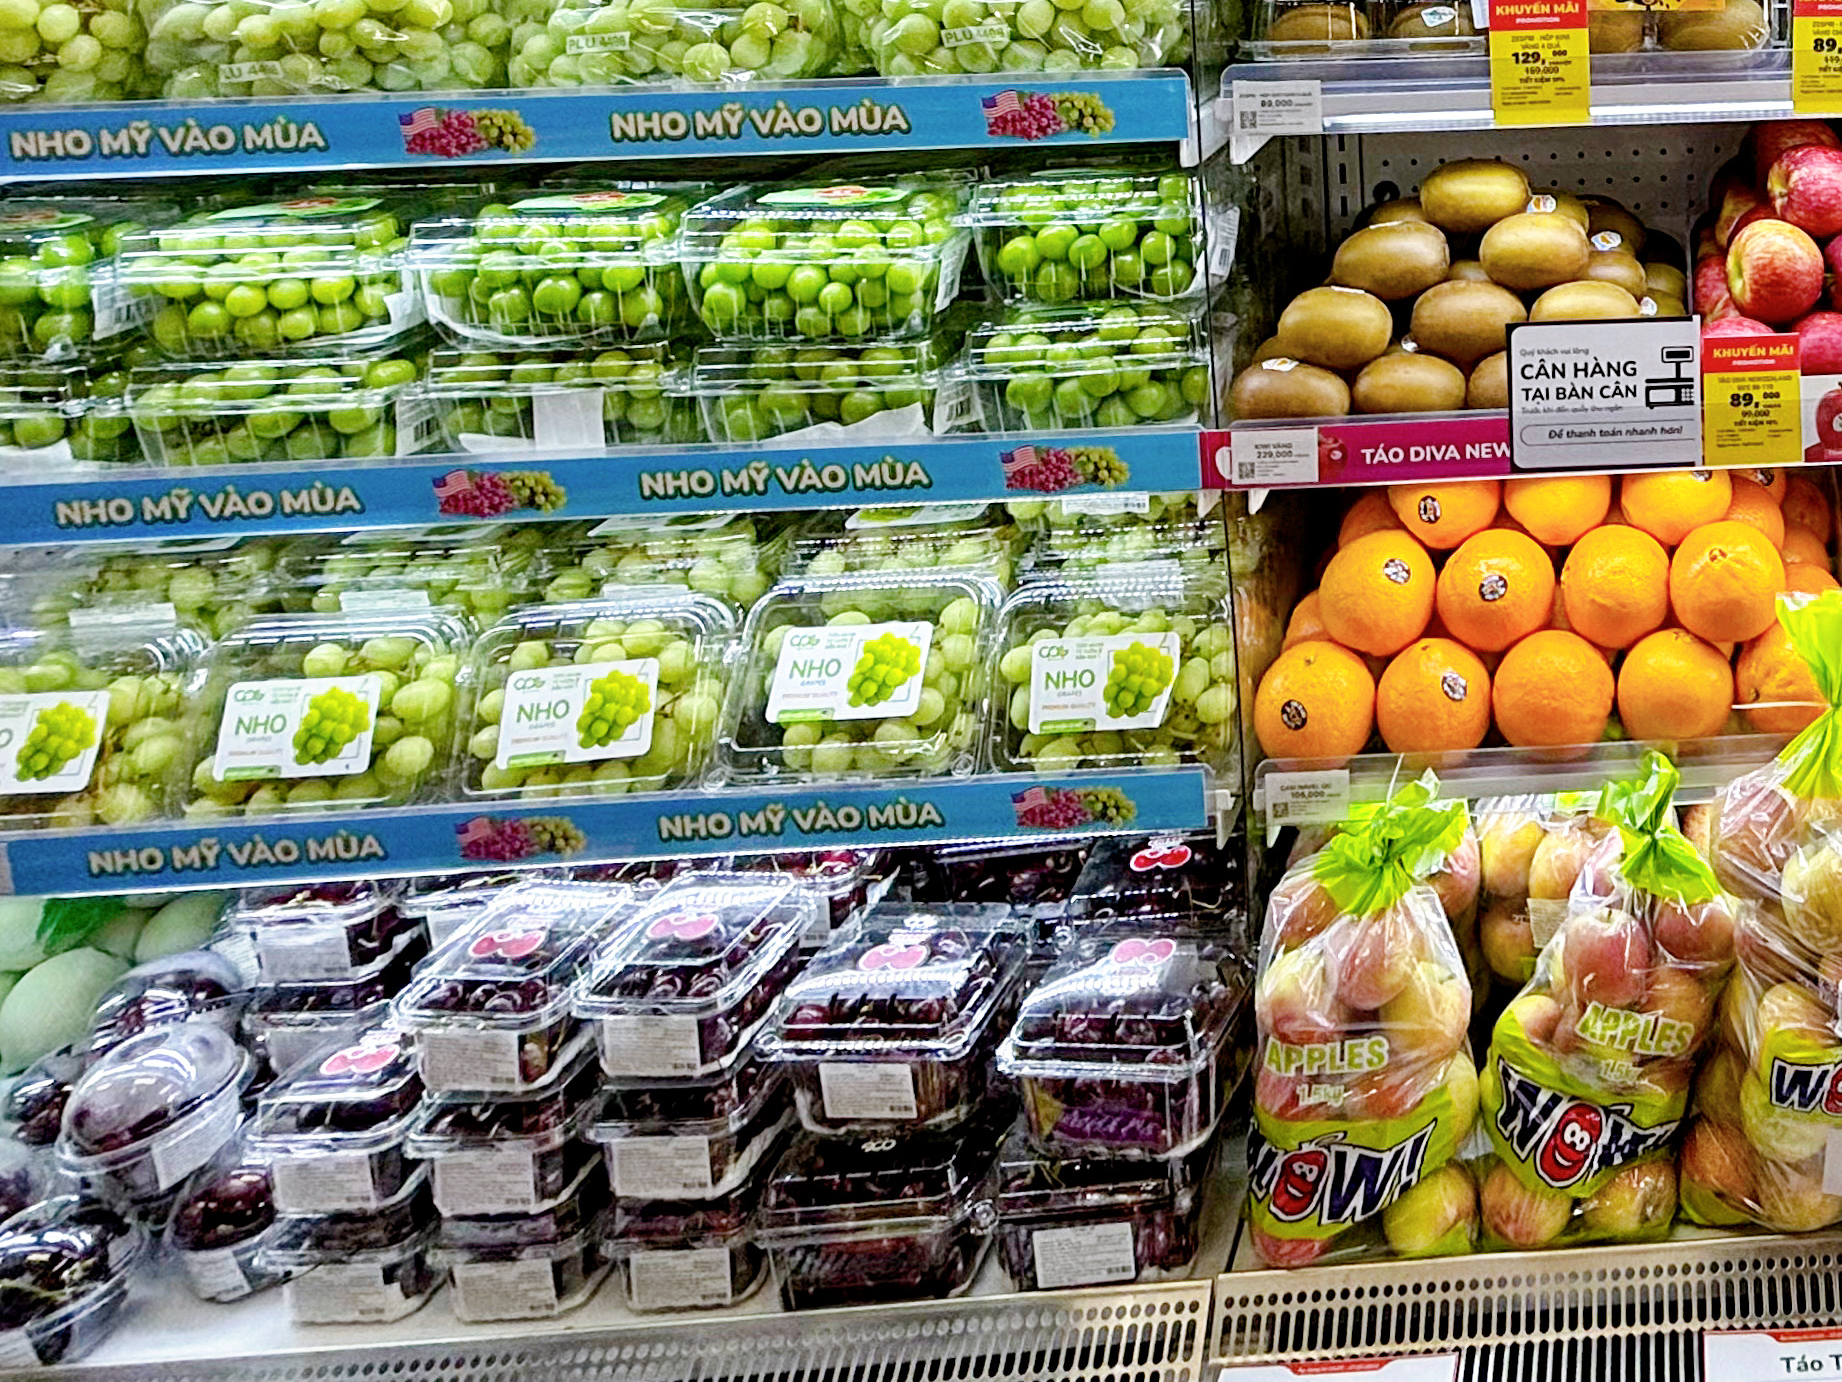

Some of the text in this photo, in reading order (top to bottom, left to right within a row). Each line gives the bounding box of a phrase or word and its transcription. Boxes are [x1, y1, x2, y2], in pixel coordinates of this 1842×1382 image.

[1495, 0, 1580, 17] KHUYẾN MÃI
[611, 98, 910, 142] NHO MỸ VÀO MÙA
[10, 116, 326, 161] NHO MỸ VÀO MÙA
[1713, 344, 1794, 359] KHUYẾN MÃI
[1520, 356, 1637, 380] CÂN HÀNG
[1521, 381, 1637, 405] TẠI BÀN CÂN
[1548, 425, 1683, 439] Để thanh toán nhanh hơn!
[1360, 441, 1461, 466] TÁO DIVA
[640, 454, 932, 499] NHO MỸ VÀO MÙA
[55, 479, 364, 527] NHO MỸ VÀO MÙA
[789, 658, 841, 679] NHO
[1044, 669, 1095, 692] NHO
[516, 699, 570, 723] NHO
[234, 713, 287, 736] NHO
[659, 797, 944, 842] NHO MỸ VÀO MÙA
[89, 829, 385, 877] NHO MỸ VÀO MÙA
[1578, 1001, 1697, 1056] APPLES
[1264, 1035, 1390, 1078] APPLES
[1780, 1353, 1825, 1373] Táo
